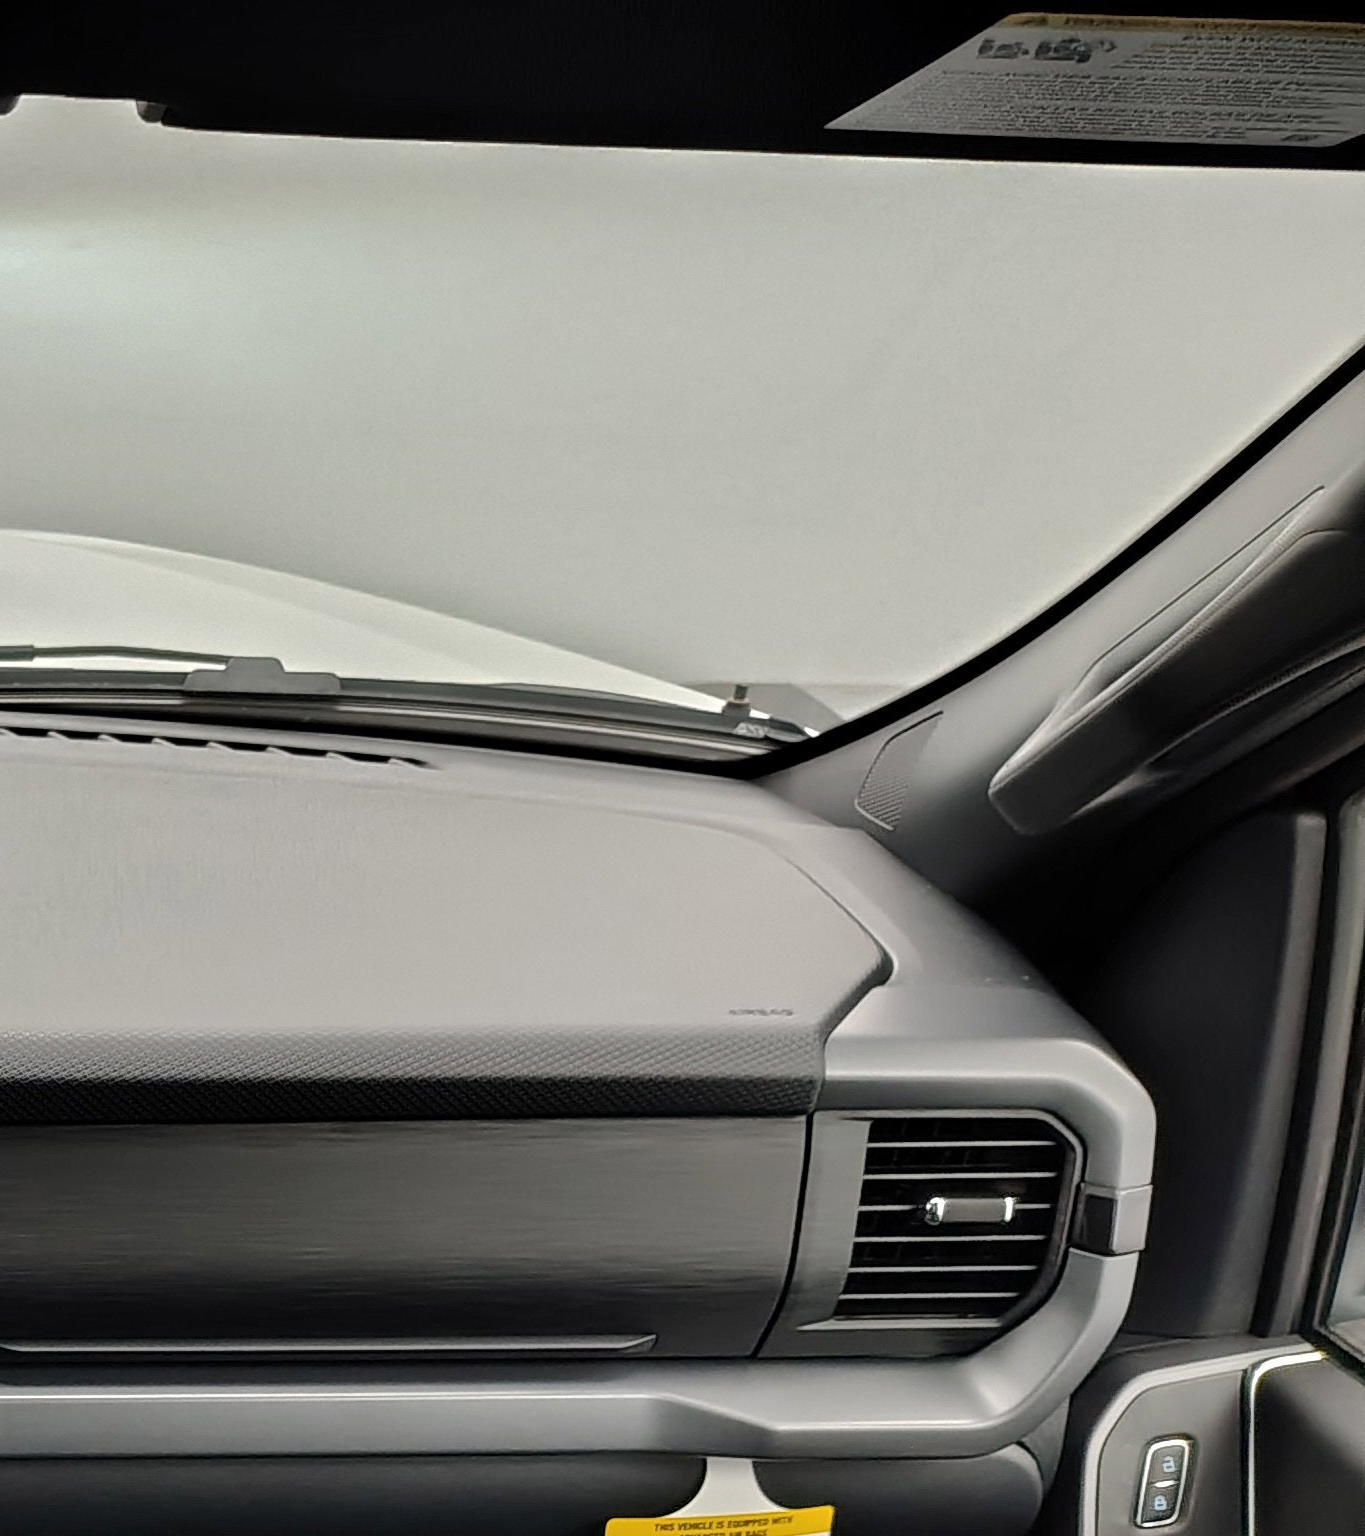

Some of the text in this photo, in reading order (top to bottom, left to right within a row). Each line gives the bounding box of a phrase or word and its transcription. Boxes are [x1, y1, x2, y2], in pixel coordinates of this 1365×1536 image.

[654, 1523, 675, 1532] THIS
[677, 1521, 713, 1531] VEHICLE
[715, 1520, 724, 1529] IS
